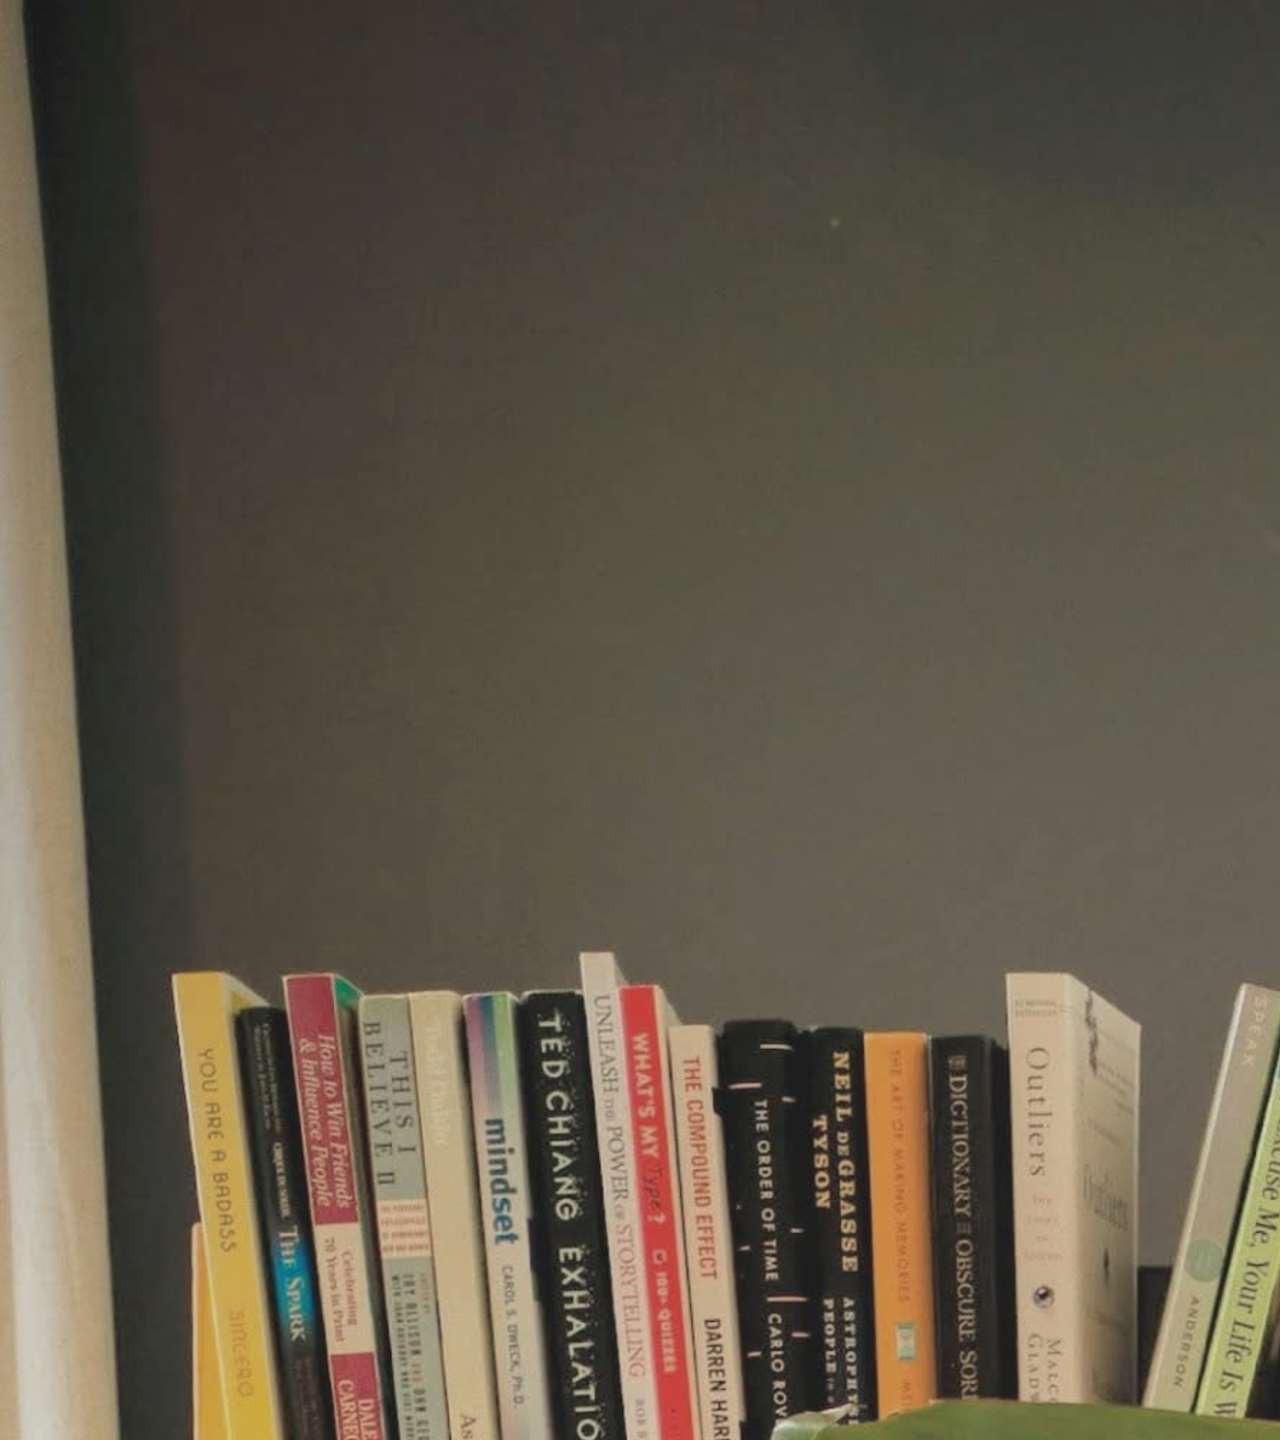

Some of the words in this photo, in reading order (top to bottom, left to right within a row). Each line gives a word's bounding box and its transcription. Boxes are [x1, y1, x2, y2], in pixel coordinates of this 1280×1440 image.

[300, 1040, 315, 1053] &
[317, 1034, 336, 1074] How
[537, 1008, 565, 1078] TED
[198, 1049, 217, 1092] YOU
[325, 1082, 337, 1098] to
[683, 1057, 702, 1091] THE
[204, 1102, 224, 1140] ARE
[303, 1060, 325, 1143] Influence
[325, 1101, 342, 1142] Win
[754, 1100, 769, 1132] THE
[1025, 1047, 1053, 1177] Outliers
[211, 1151, 226, 1163] A
[331, 1143, 352, 1208] Friends
[546, 1091, 578, 1220] CHIANG
[687, 1097, 710, 1206] COMPOUND
[756, 1140, 774, 1200] ORDER
[311, 1146, 330, 1207] People
[485, 1119, 519, 1244] mindset
[212, 1172, 237, 1252] BADASS
[761, 1208, 776, 1231] OF
[696, 1215, 717, 1279] EFFECT
[763, 1239, 778, 1281] TIME
[1234, 1256, 1270, 1310] Your
[703, 1319, 726, 1391] DARREN
[1226, 1319, 1255, 1364] Life
[1219, 1370, 1244, 1392] Is
